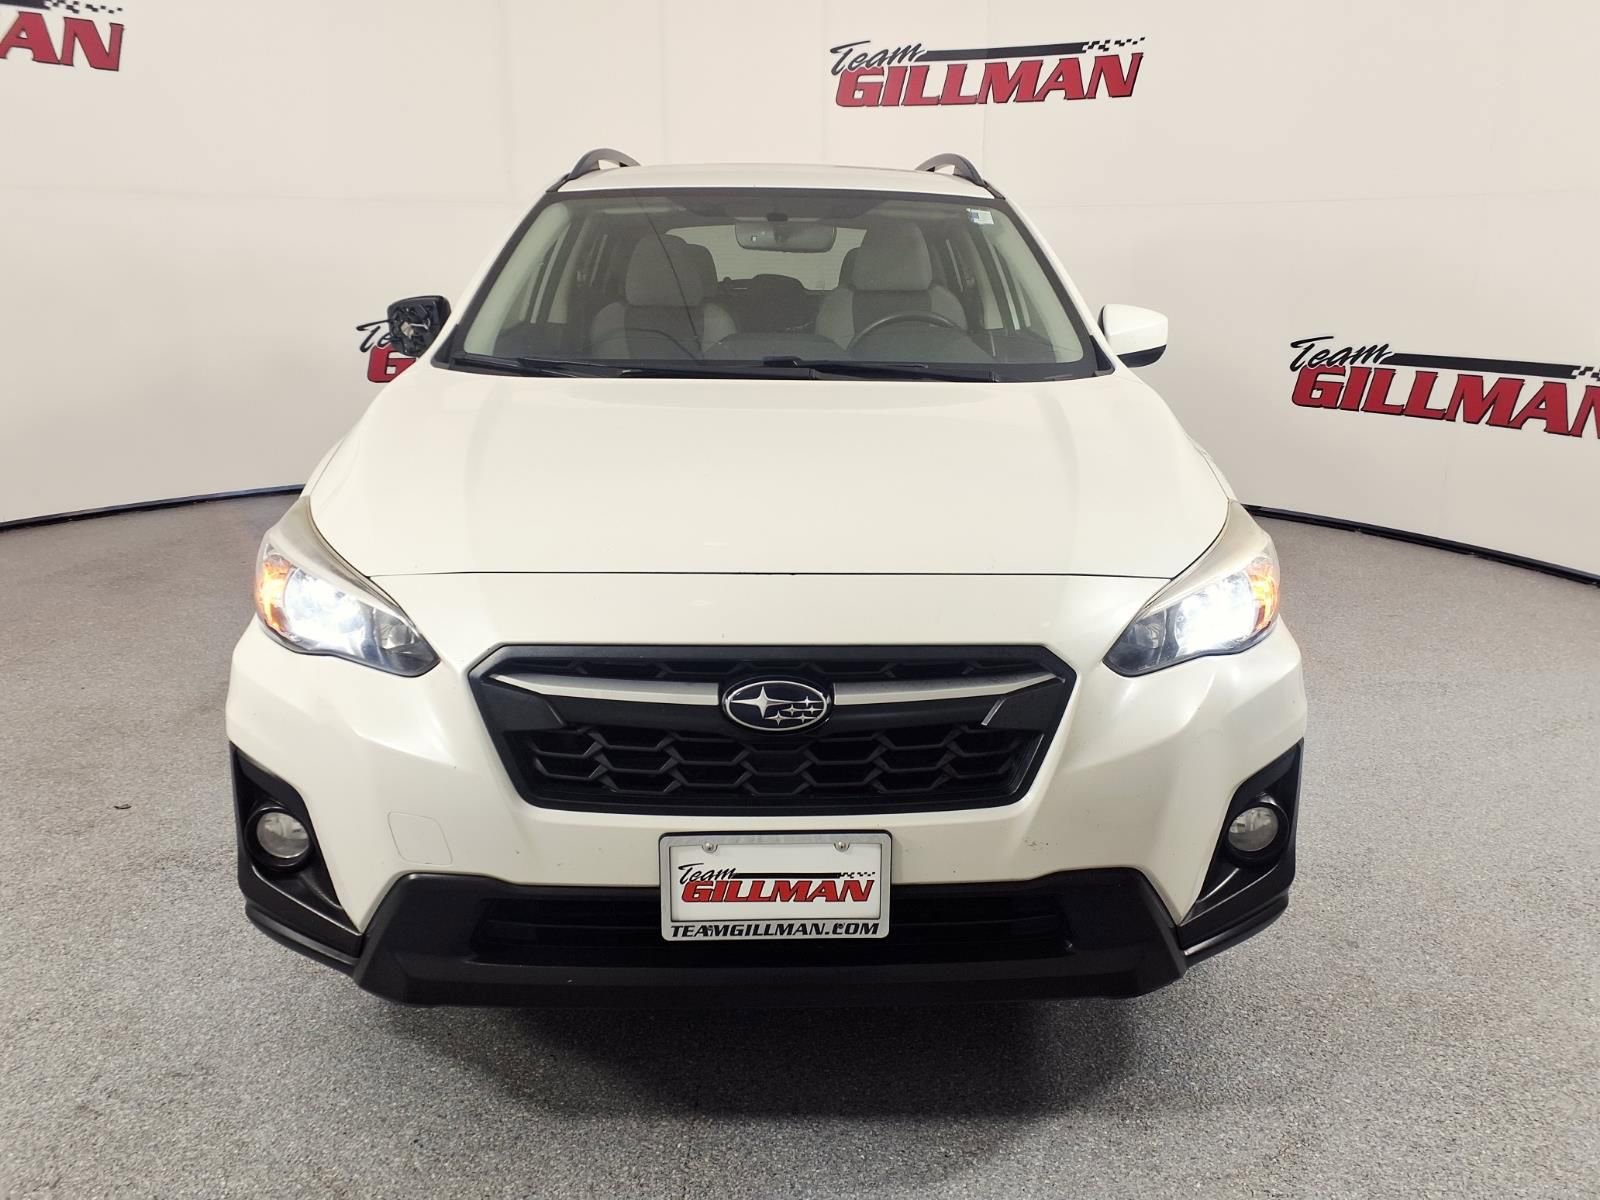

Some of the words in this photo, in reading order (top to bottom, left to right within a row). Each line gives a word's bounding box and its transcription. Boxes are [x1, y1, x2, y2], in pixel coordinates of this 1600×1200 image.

[830, 40, 926, 76] Team
[836, 52, 1144, 107] GILLMAN
[1290, 336, 1392, 371] Team
[678, 863, 736, 885] Team
[681, 880, 874, 903] GILLMAN
[671, 923, 879, 938] TEAMGILLMAN.COM
